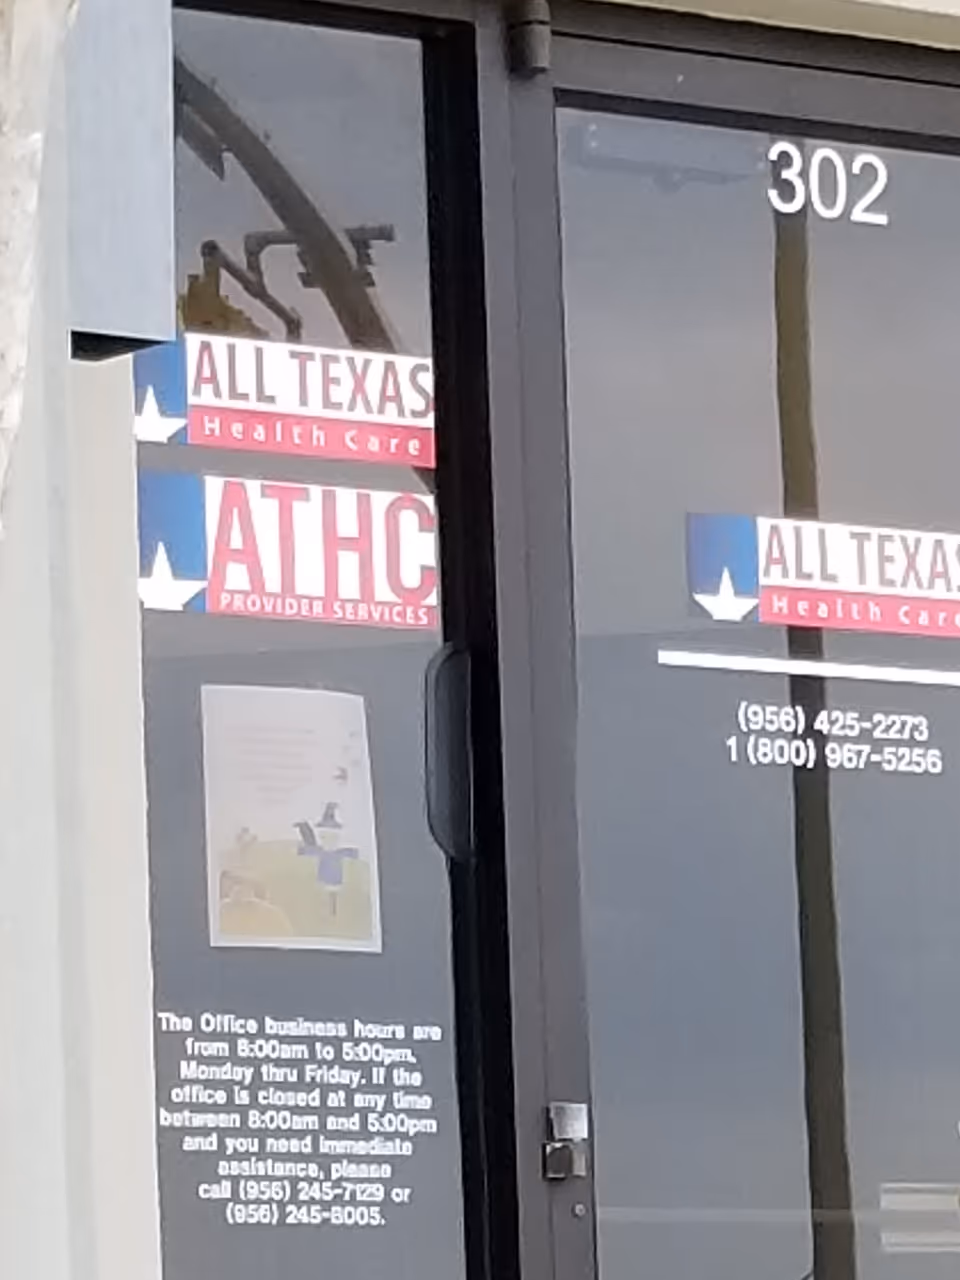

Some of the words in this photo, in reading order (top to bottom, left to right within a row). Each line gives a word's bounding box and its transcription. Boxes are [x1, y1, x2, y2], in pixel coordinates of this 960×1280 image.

[767, 141, 889, 225] 302
[192, 340, 276, 404] ALL
[289, 349, 435, 420] TEXAS
[204, 415, 325, 447] Health
[345, 429, 420, 456] Care
[208, 480, 437, 603] ATHC
[763, 523, 838, 583] ALL
[220, 592, 324, 616] PROVIDER
[333, 600, 429, 625] SERVICES
[772, 594, 882, 621] Health
[737, 701, 805, 732] (956)
[813, 709, 929, 741] 425-2273
[726, 736, 738, 762] 1
[747, 736, 817, 769] (800)
[825, 743, 943, 774] 967-5256
[157, 1012, 193, 1032] The
[201, 1013, 258, 1034] Office
[265, 1016, 347, 1037] business
[354, 1019, 405, 1039] hours
[413, 1023, 442, 1041] are
[185, 1037, 229, 1057] from
[315, 1043, 334, 1060] to
[180, 1060, 254, 1085] Monday
[260, 1063, 298, 1082] thru
[393, 1067, 422, 1086] the
[171, 1085, 227, 1105] office
[233, 1086, 250, 1105] is
[257, 1087, 320, 1107] closed
[327, 1090, 346, 1107] at
[354, 1094, 386, 1112] any
[393, 1092, 432, 1110] time
[159, 1108, 240, 1128] between
[248, 1109, 319, 1130] 8:00am
[326, 1113, 359, 1131] and
[367, 1113, 438, 1136] 5:00pm
[182, 1133, 218, 1151] and
[225, 1136, 259, 1155] you
[266, 1135, 312, 1153] need
[319, 1135, 412, 1156] immediate
[331, 1159, 392, 1180] please
[198, 1180, 232, 1199] call
[238, 1179, 291, 1201] (956)
[391, 1187, 412, 1203] or
